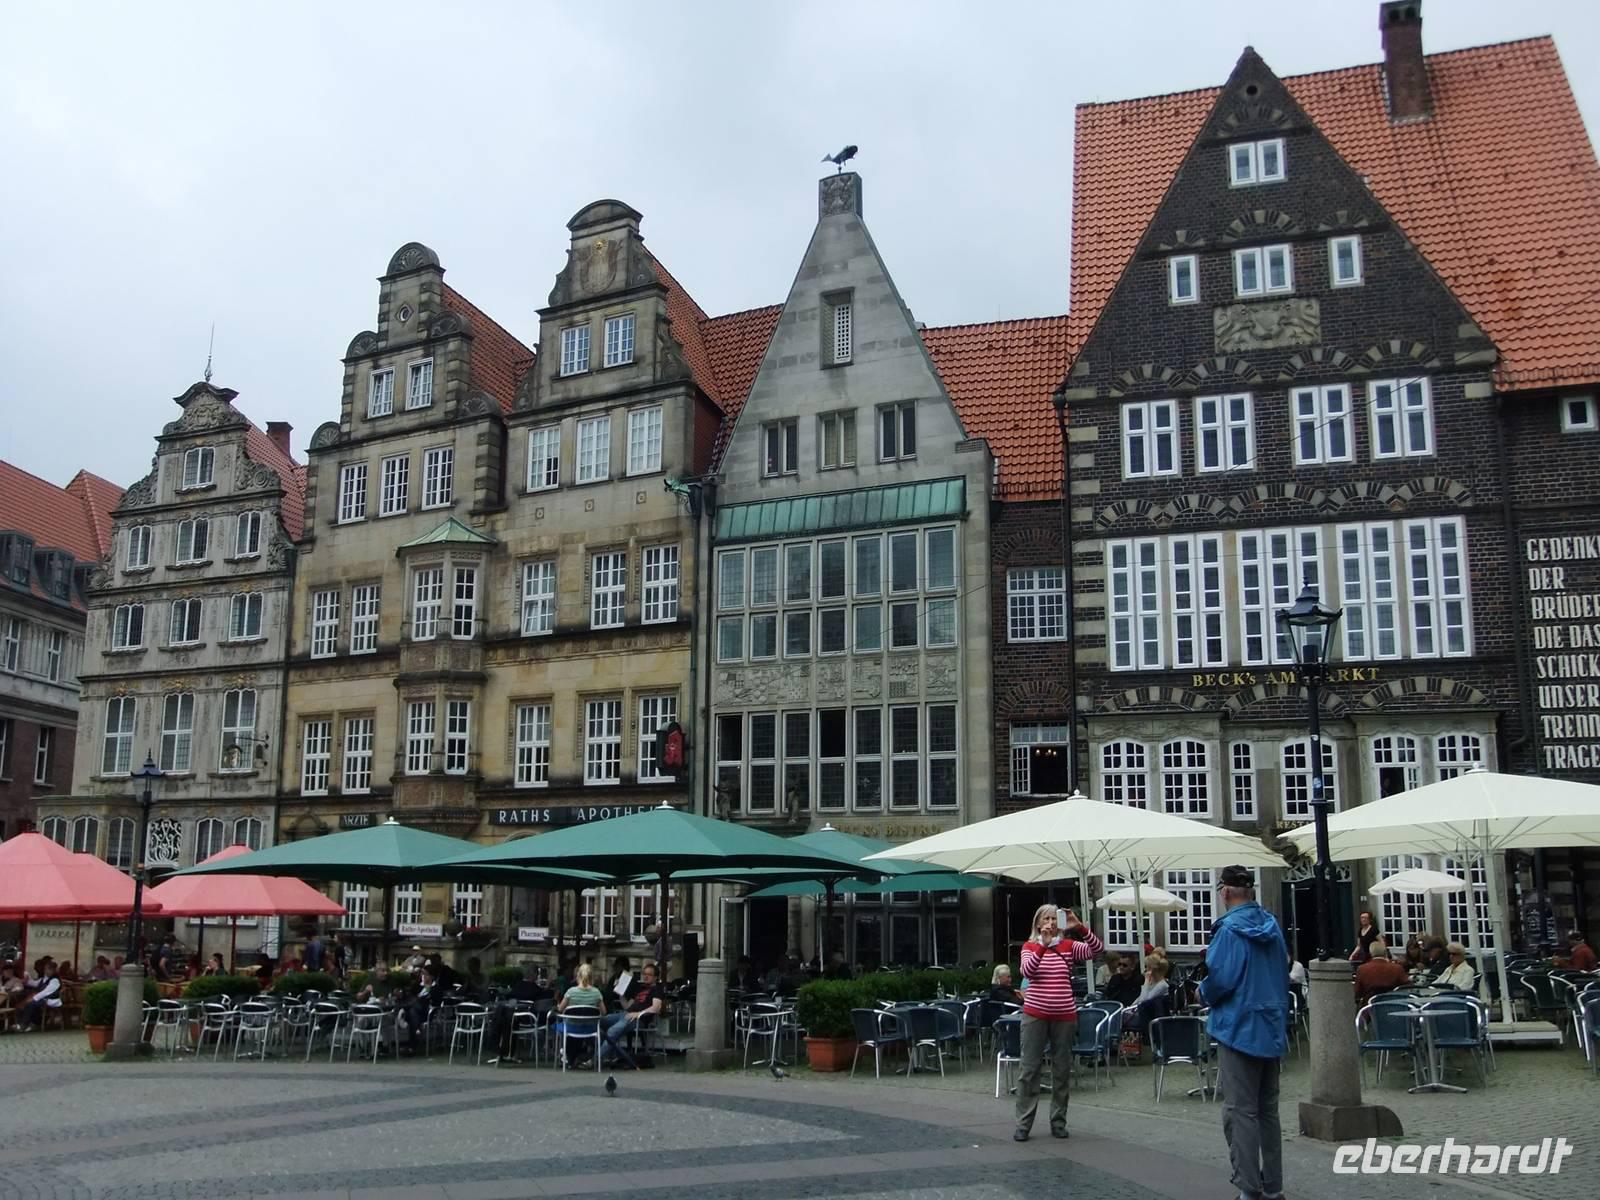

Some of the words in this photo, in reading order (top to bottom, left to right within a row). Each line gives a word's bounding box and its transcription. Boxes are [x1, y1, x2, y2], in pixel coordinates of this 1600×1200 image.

[1526, 535, 1600, 561] GEDENK
[1528, 567, 1565, 590] DER
[1534, 625, 1564, 649] DIE
[1569, 623, 1600, 647] DAS
[1265, 671, 1296, 686] AM
[1327, 667, 1379, 682] ARKT
[1538, 683, 1600, 708] UNSER
[499, 809, 550, 823] RATHS
[576, 806, 653, 821] APOTH
[1276, 820, 1310, 829] REST
